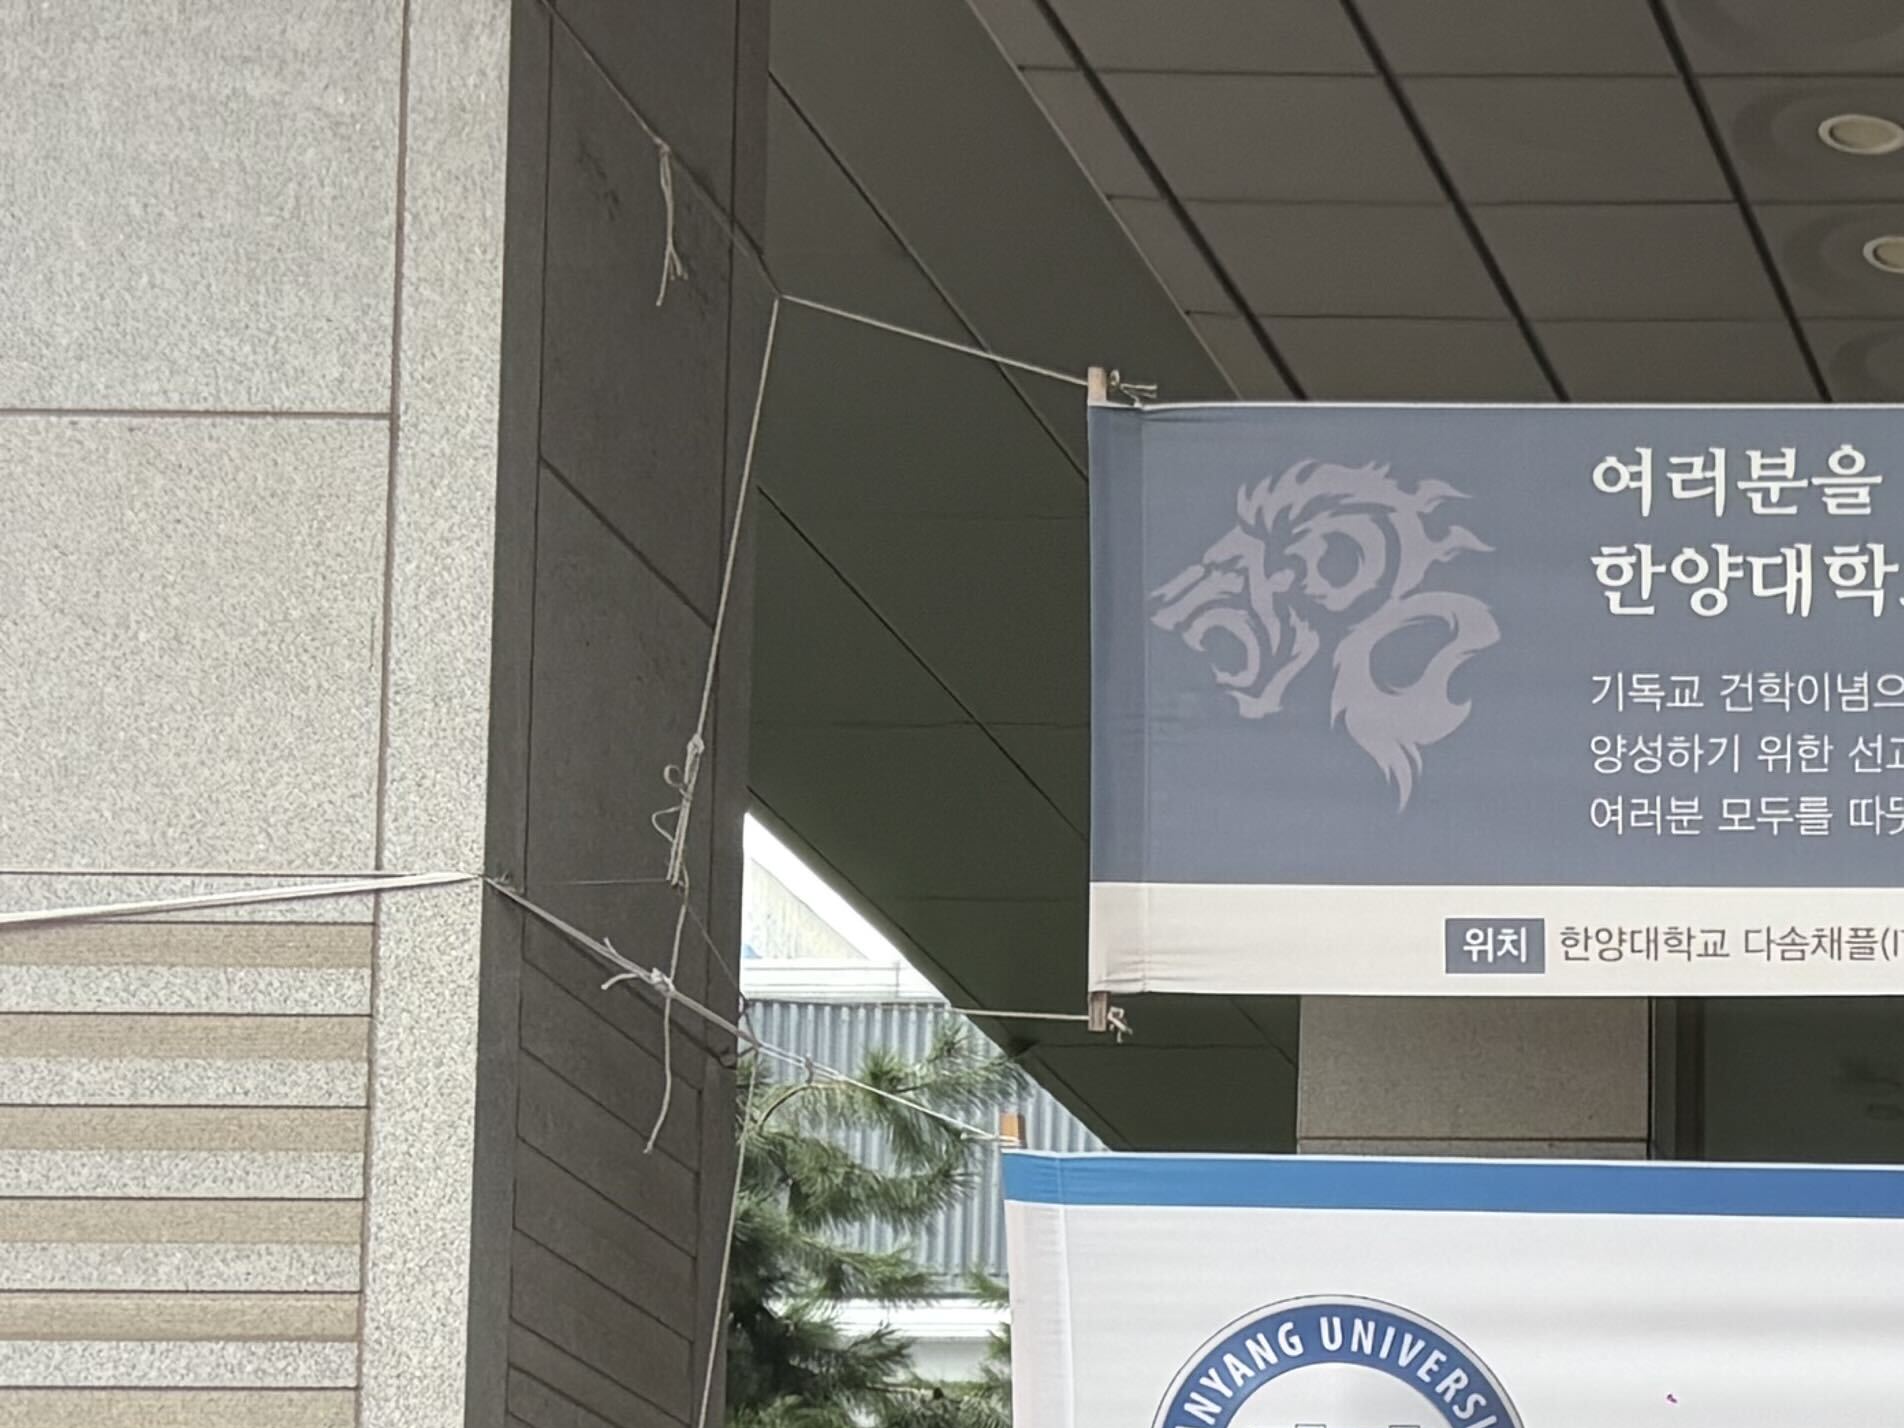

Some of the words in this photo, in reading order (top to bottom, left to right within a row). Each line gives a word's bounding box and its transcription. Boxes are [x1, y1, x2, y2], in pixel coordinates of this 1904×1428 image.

[1593, 445, 1882, 517] 여러분을
[1592, 672, 1704, 712] 기독교
[1591, 734, 1738, 773] 양성하기
[1758, 734, 1833, 773] 위한
[1591, 796, 1703, 835] 여러분
[1719, 797, 1832, 835] 모두를
[1462, 928, 1529, 965] 위치
[1558, 926, 1730, 964] 한양대학교
